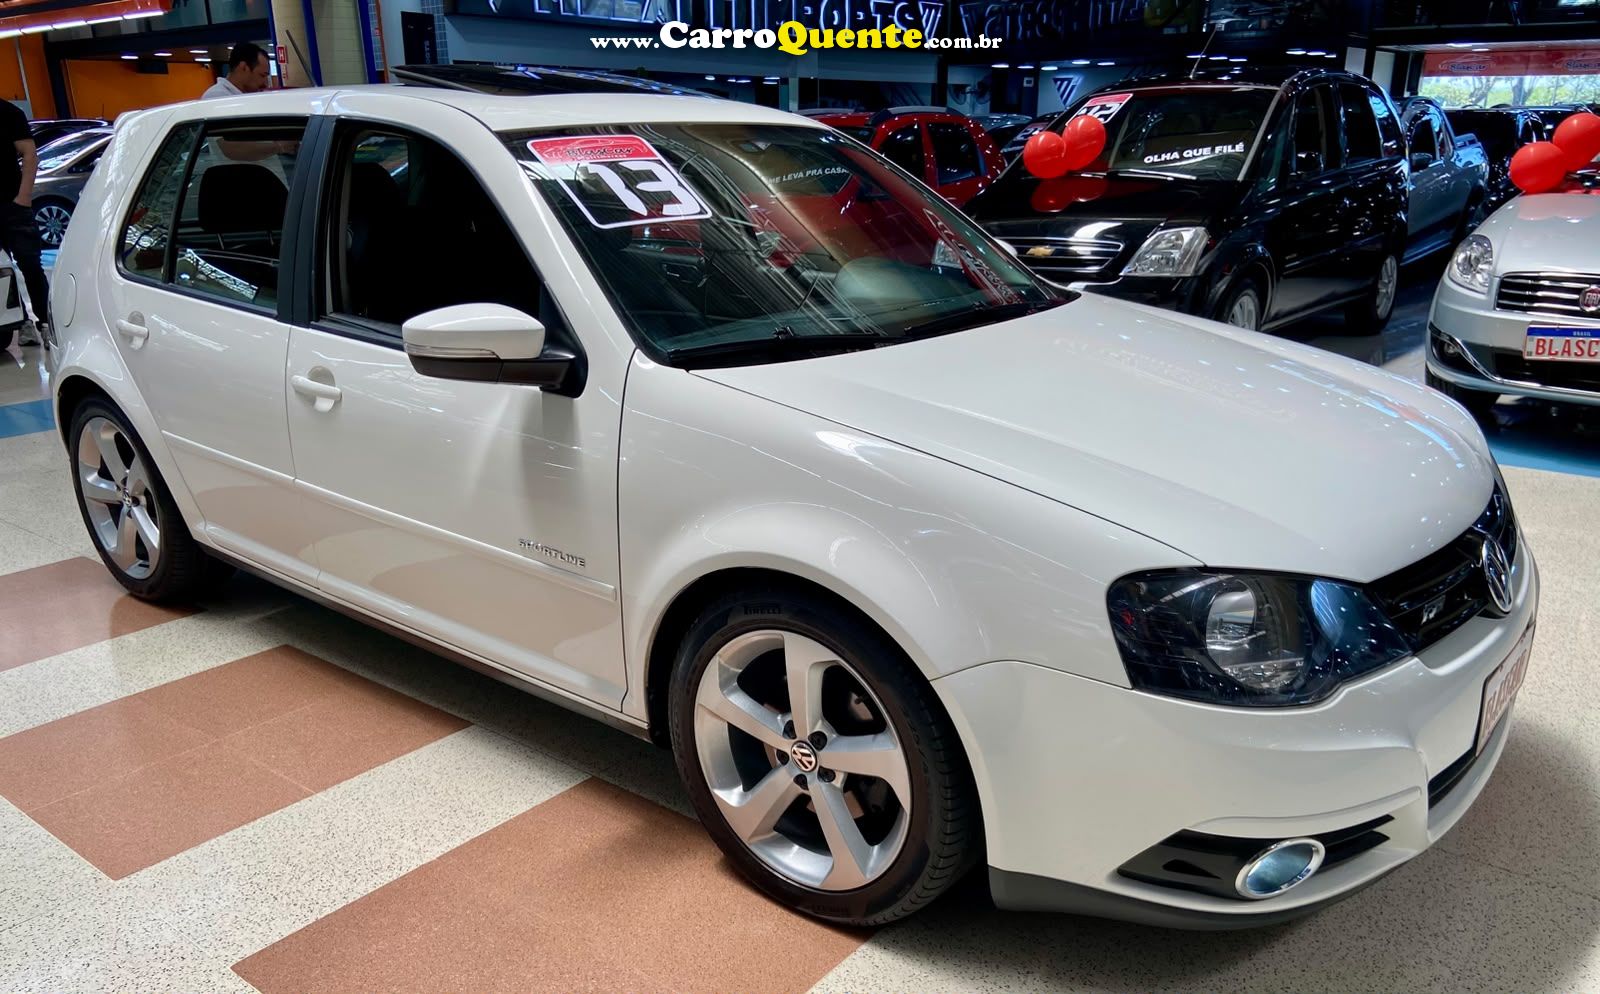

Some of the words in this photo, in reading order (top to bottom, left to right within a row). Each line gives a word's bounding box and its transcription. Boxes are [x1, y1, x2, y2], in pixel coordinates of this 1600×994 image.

[1144, 151, 1180, 164] OLHA
[1182, 147, 1212, 158] QUE
[1215, 142, 1245, 154] FILÉ
[782, 171, 804, 182] LEVA
[805, 168, 823, 177] PRA
[518, 538, 586, 567] SPORTLINE
